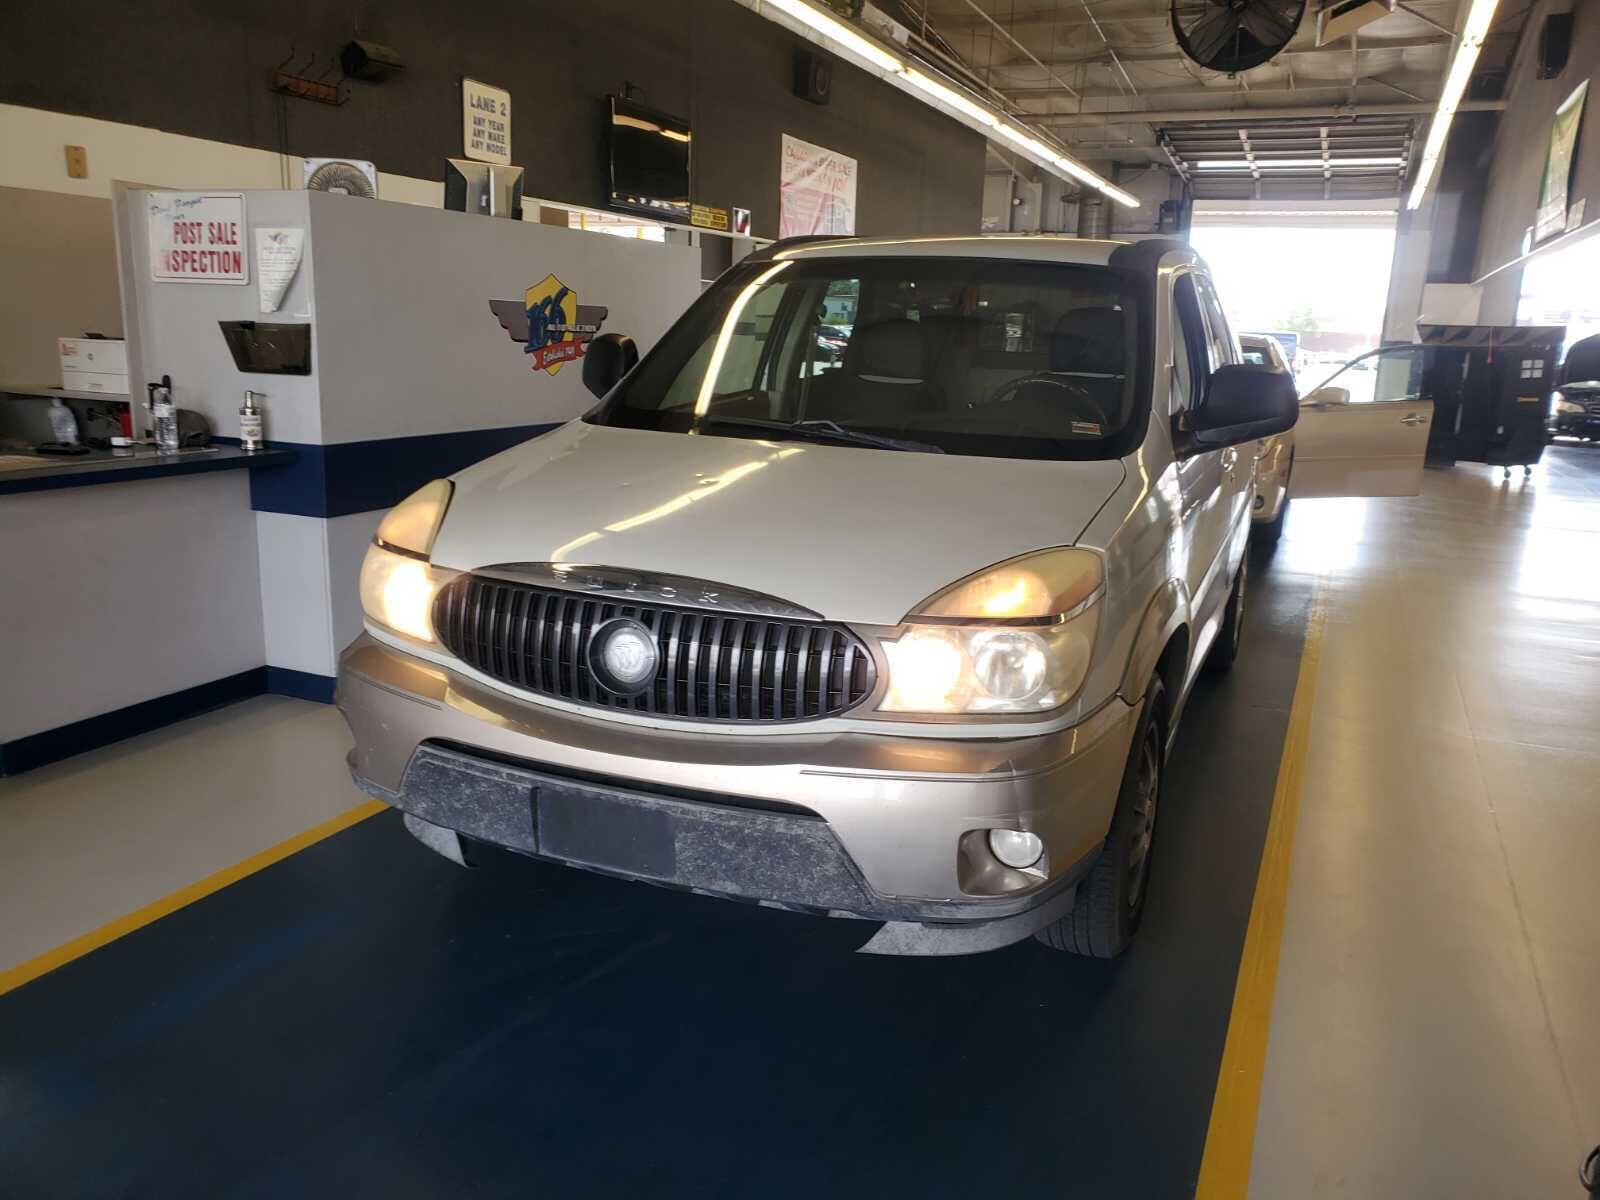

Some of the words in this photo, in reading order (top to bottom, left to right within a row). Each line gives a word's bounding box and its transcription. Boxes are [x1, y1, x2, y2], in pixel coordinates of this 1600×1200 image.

[470, 93, 496, 114] LANE
[500, 102, 507, 117] 2
[473, 116, 485, 128] ANY
[488, 119, 505, 133] YEAR
[473, 127, 485, 139] ANY
[488, 131, 505, 145] MAKE
[472, 138, 483, 151] ANY
[486, 142, 507, 156] MODEL
[173, 221, 203, 245] POST
[208, 221, 238, 246] SALE
[158, 249, 243, 274] NSPECTION
